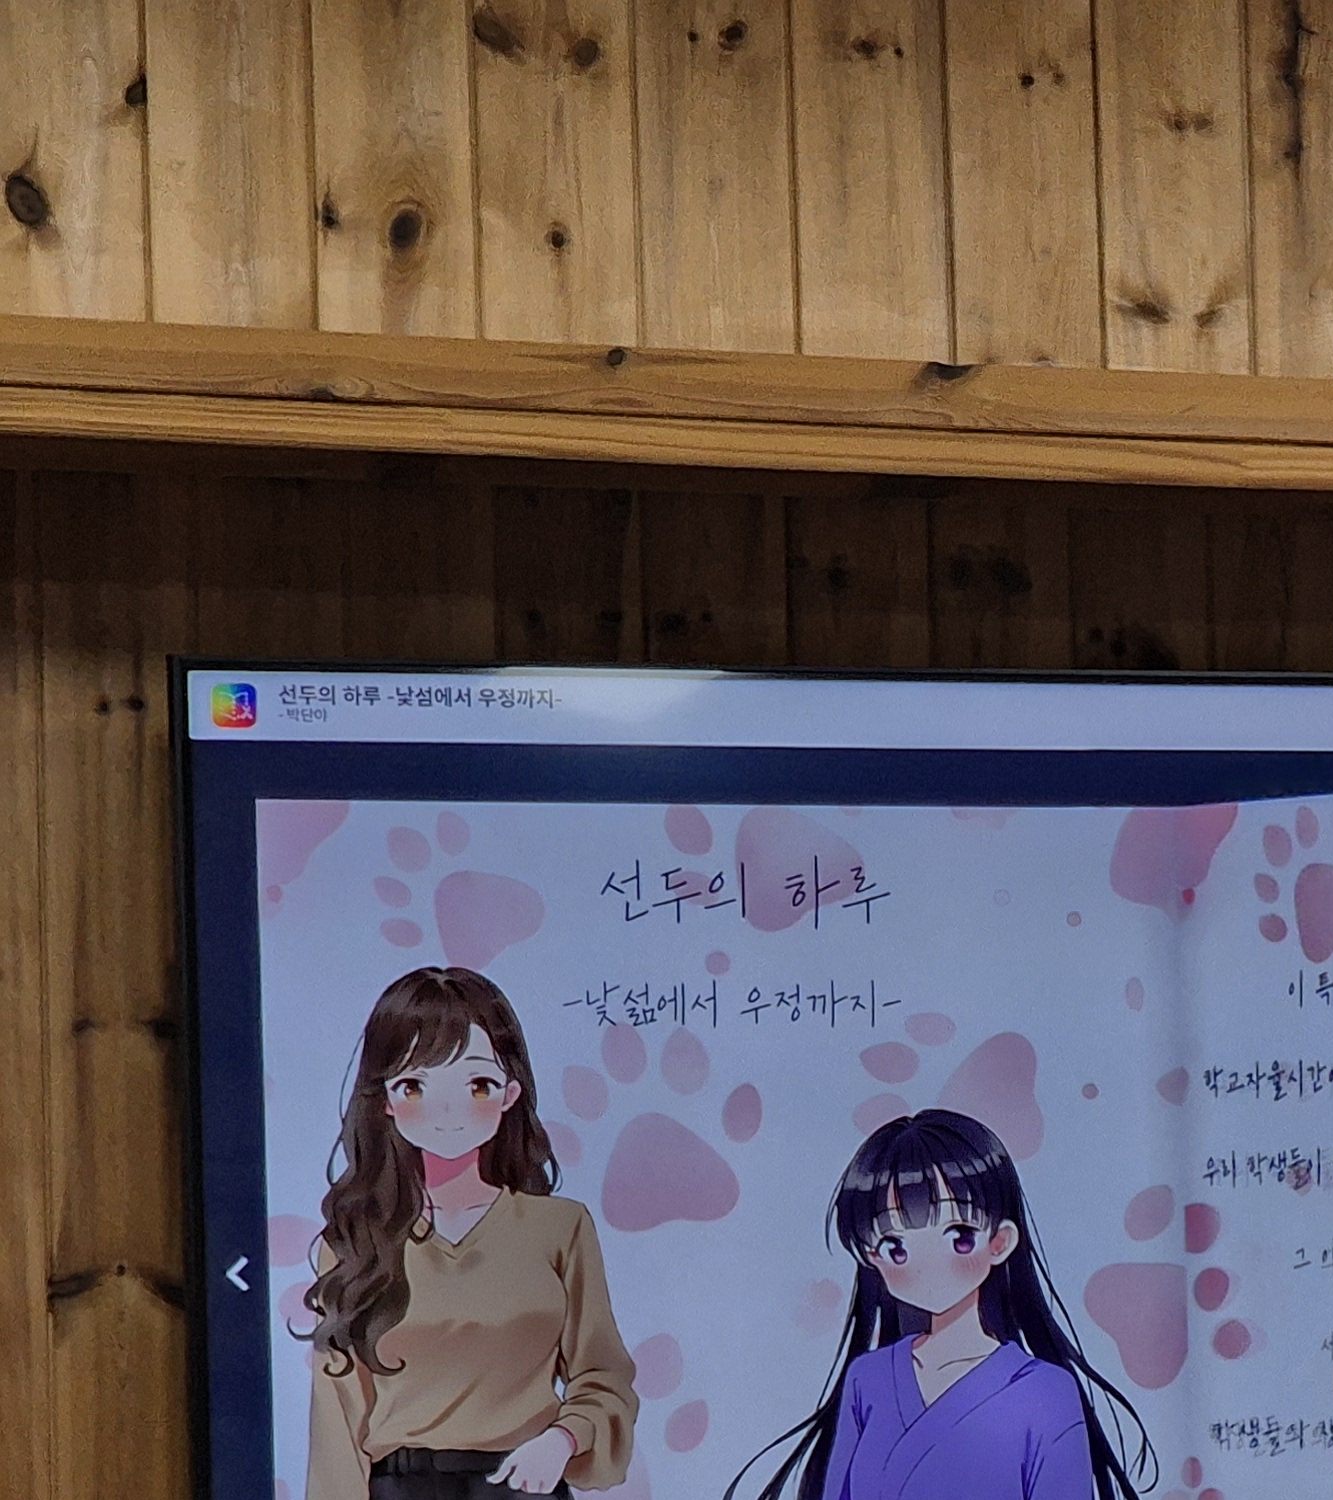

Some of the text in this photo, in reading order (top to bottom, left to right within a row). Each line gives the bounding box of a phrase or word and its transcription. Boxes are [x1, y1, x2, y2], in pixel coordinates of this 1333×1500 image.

[279, 684, 336, 706] 선두의
[343, 685, 382, 706] 하루
[477, 688, 562, 709] 우정까지-
[600, 854, 892, 930] 선두의 하루
[740, 979, 902, 1028] 우정까지-
[1287, 968, 1305, 1010] 이
[1202, 1149, 1237, 1189] 우리
[1248, 1147, 1322, 1192] 학생들이
